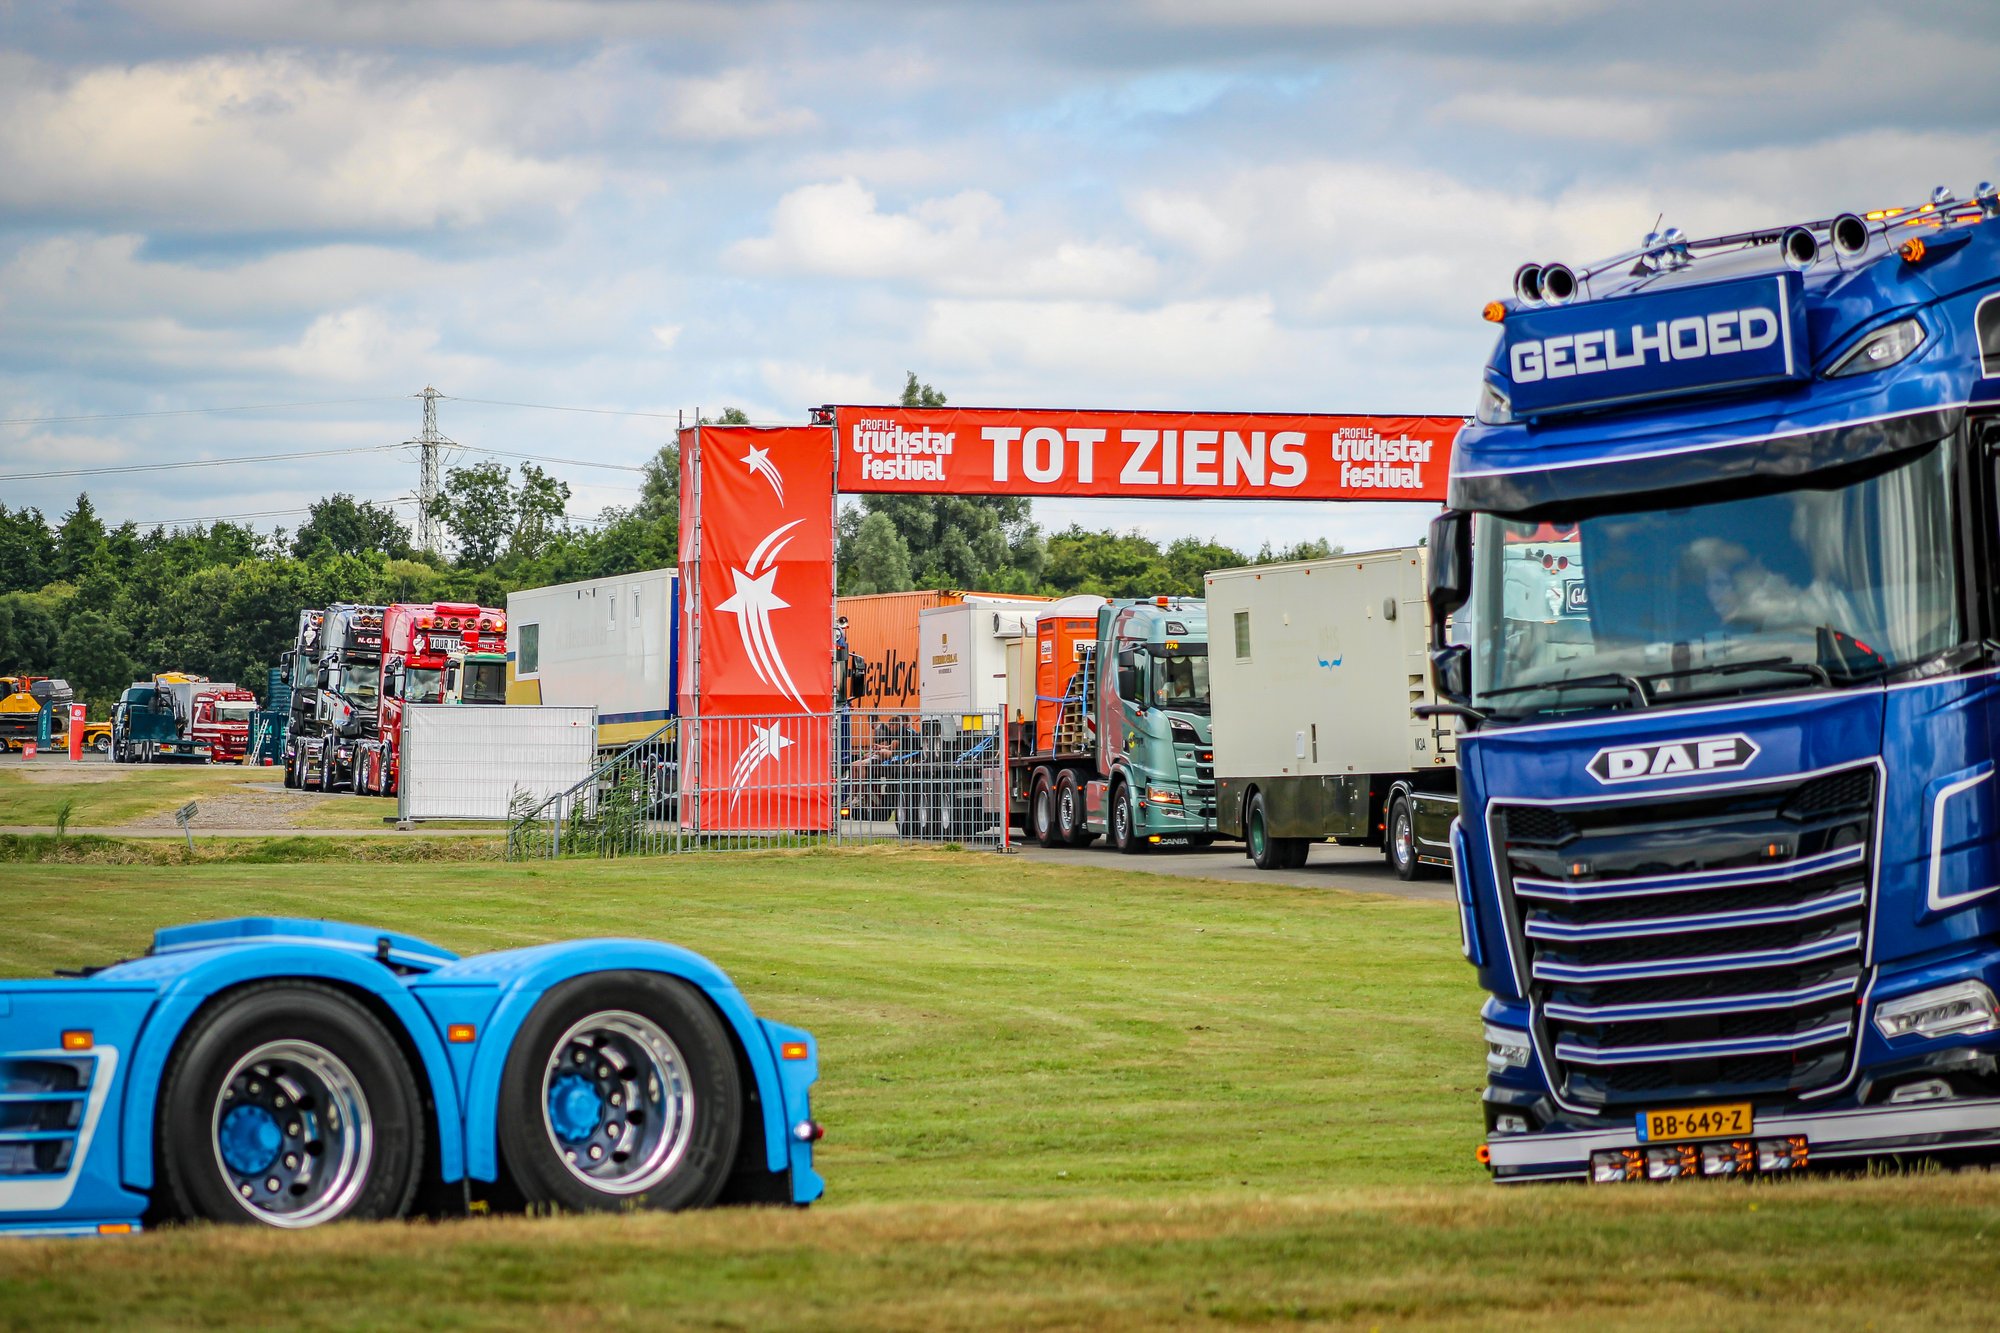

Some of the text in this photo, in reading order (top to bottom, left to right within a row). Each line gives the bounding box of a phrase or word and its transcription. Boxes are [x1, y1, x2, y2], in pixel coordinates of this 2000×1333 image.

[1510, 307, 1778, 384] GEELHOED
[853, 424, 956, 454] truckstar
[860, 419, 895, 431] PROFILE
[1340, 427, 1373, 439] PROFILE
[981, 426, 1308, 488] TOT ZIENS
[1332, 433, 1433, 462] truckstar
[862, 453, 946, 481] festival
[1341, 461, 1423, 489] festival
[430, 638, 449, 649] YOUR
[1608, 739, 1736, 779] DAF
[1652, 1110, 1743, 1136] BB-649-Z
